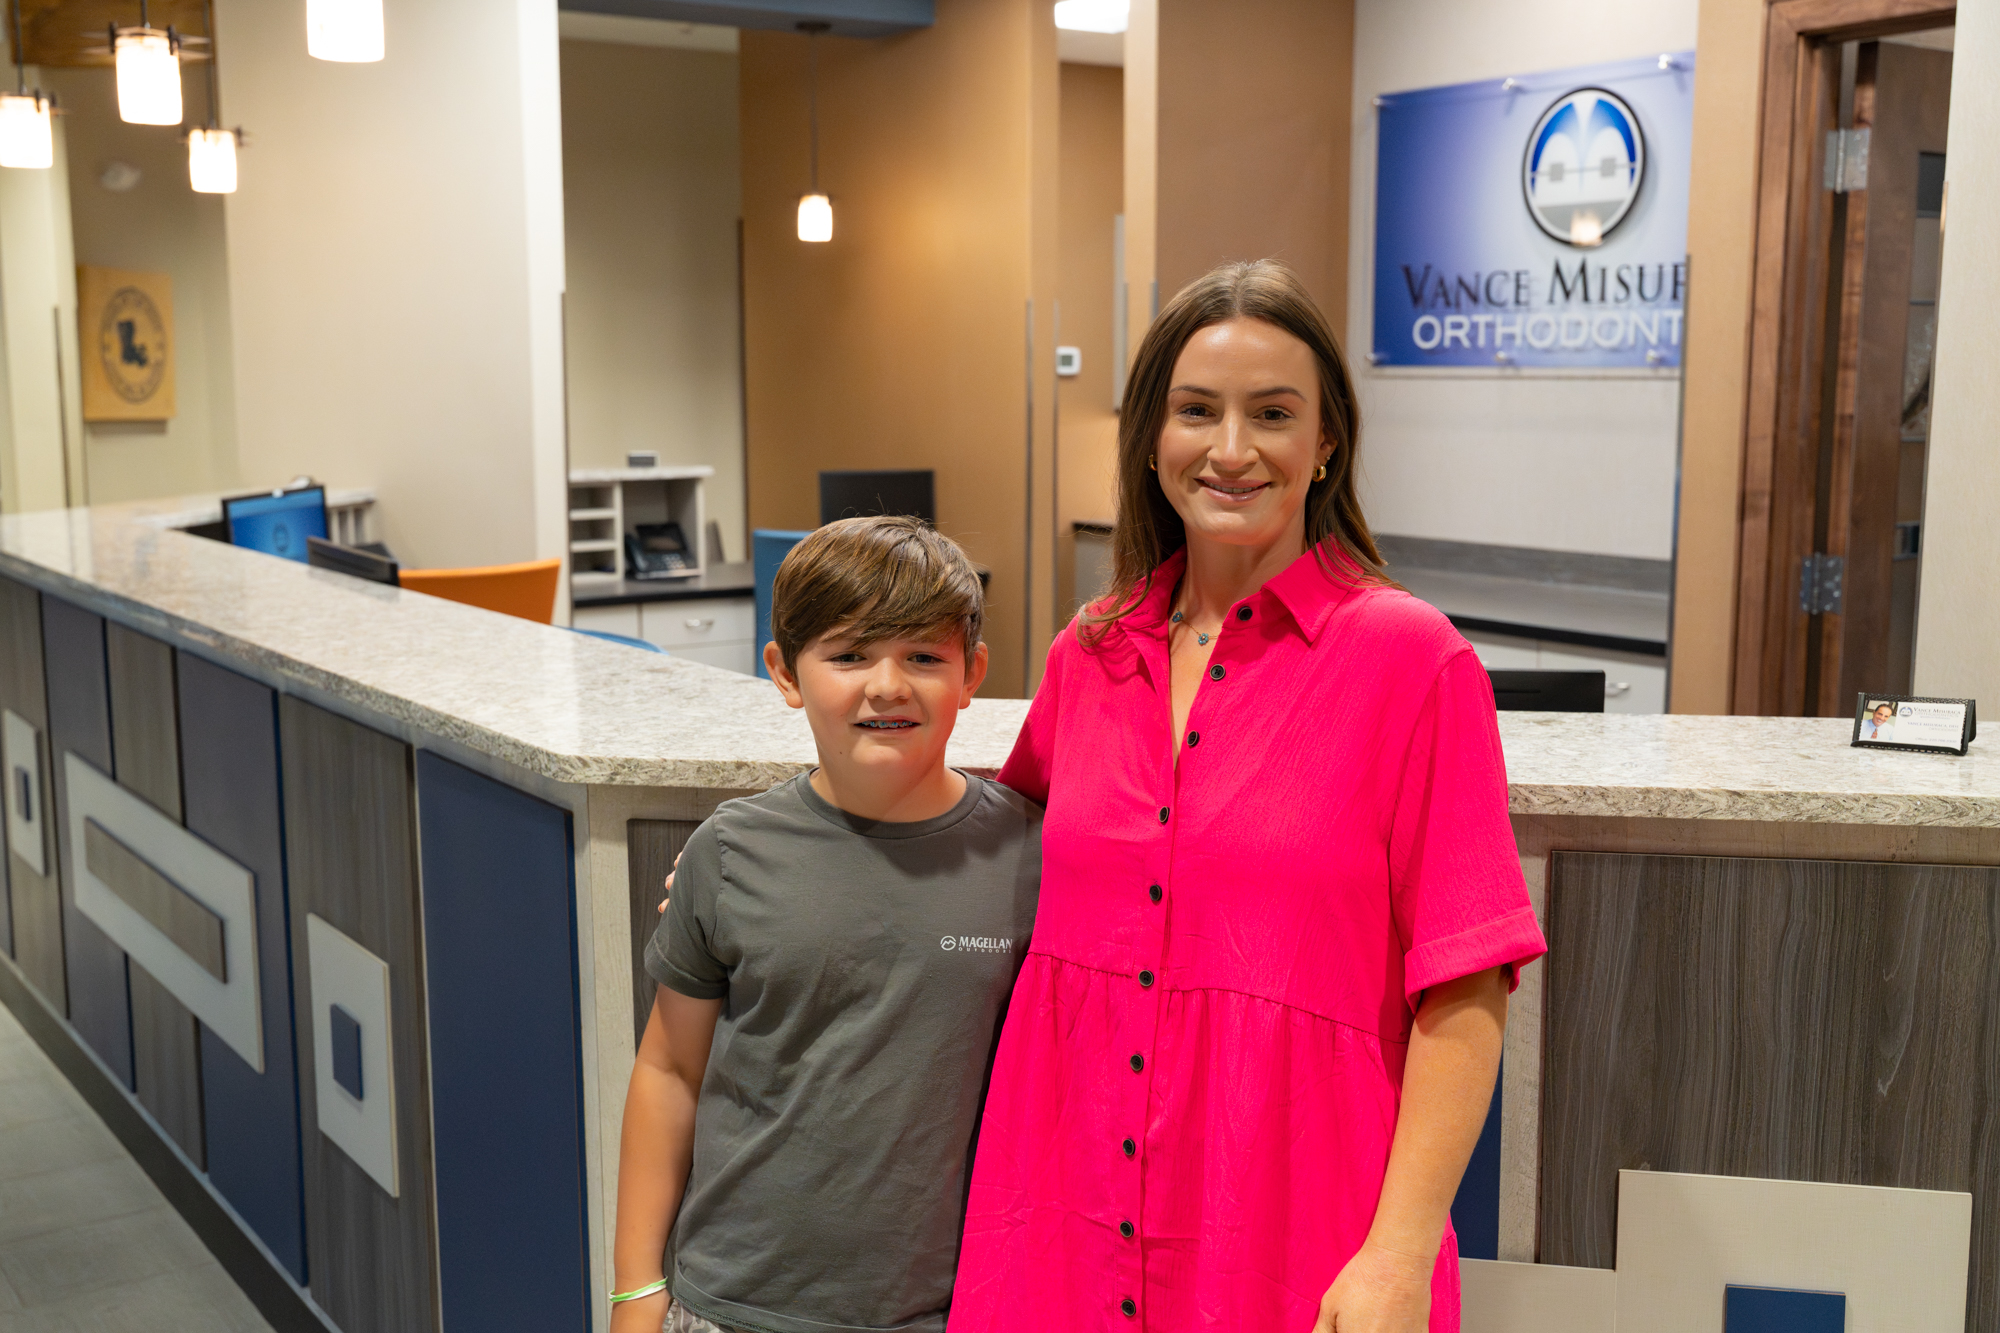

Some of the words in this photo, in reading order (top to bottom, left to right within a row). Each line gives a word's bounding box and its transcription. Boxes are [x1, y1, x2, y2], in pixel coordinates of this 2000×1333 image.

[1402, 264, 1530, 308] VANCE
[1412, 308, 1683, 350] ORTHODONT
[958, 936, 1013, 949] MAGELLAN
